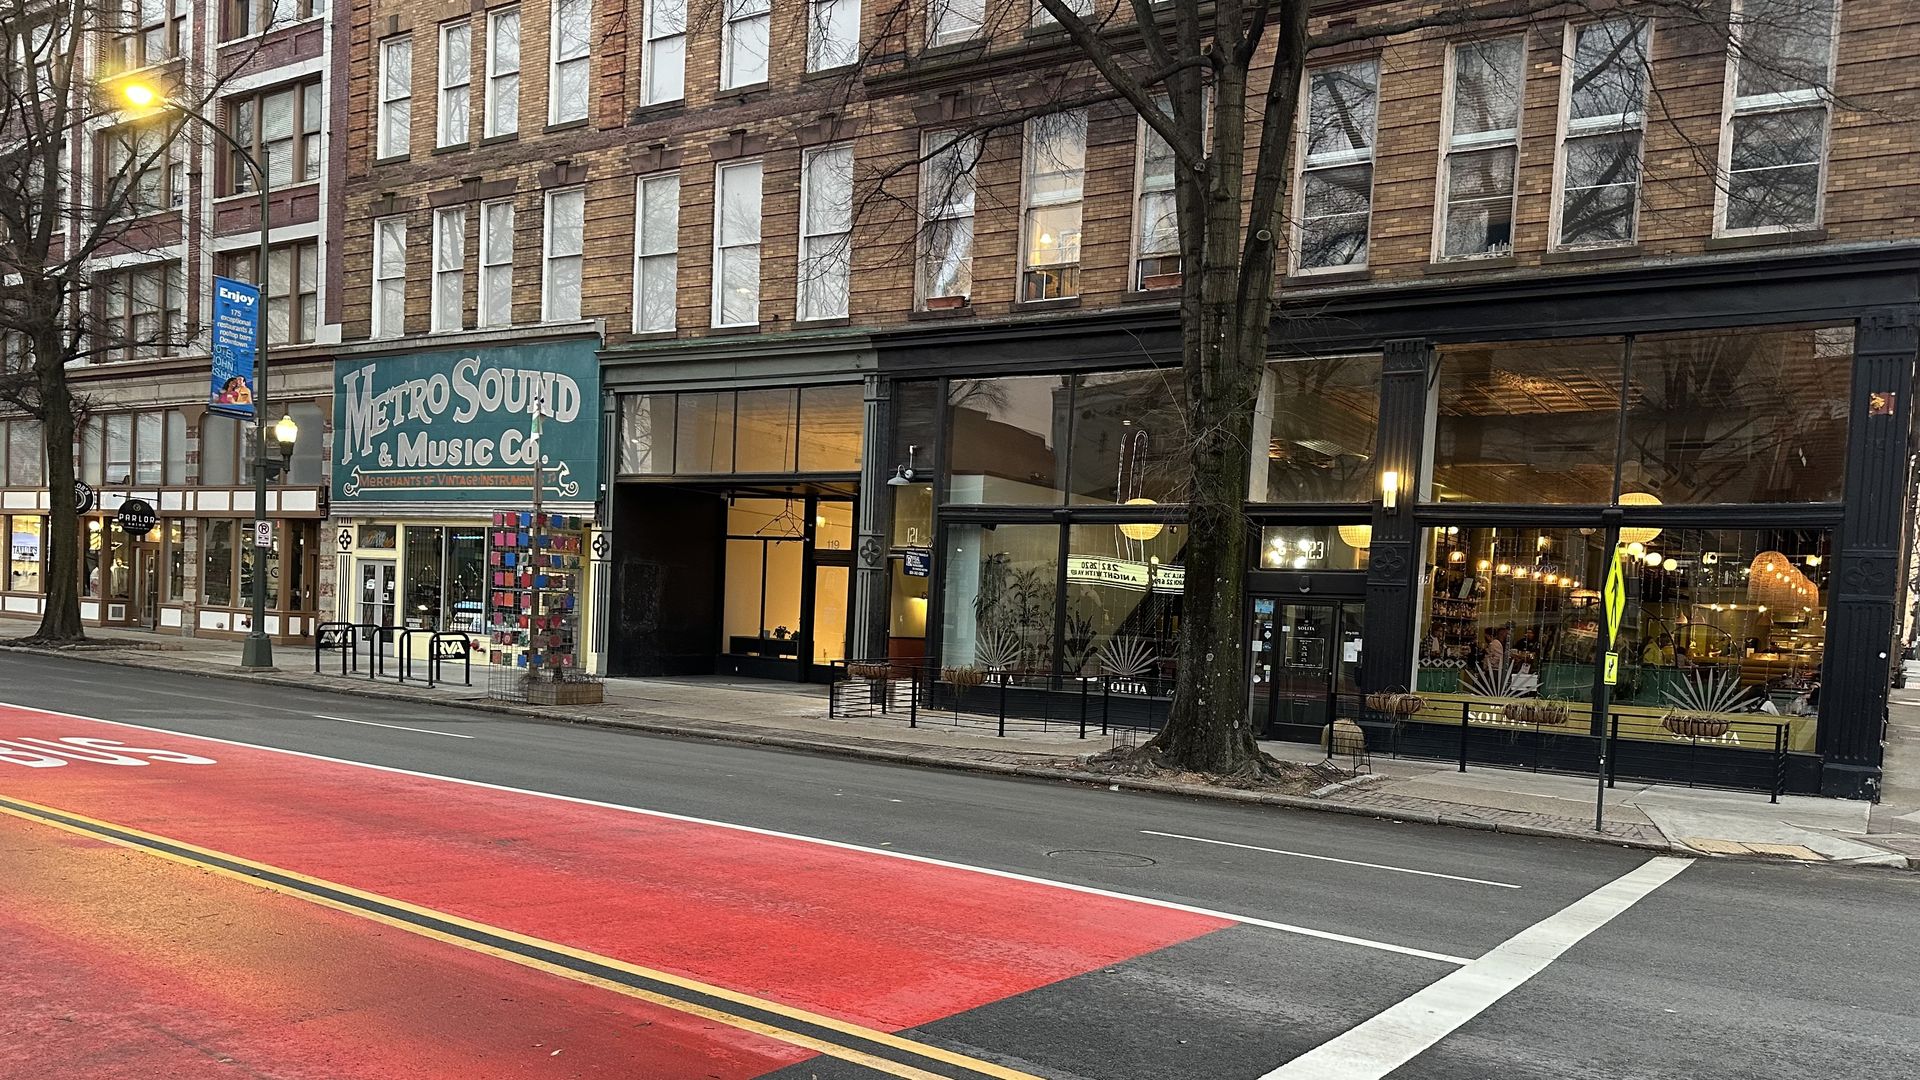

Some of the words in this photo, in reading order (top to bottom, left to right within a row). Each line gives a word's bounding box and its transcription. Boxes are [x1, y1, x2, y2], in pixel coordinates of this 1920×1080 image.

[220, 287, 255, 306] Enjoy
[231, 309, 242, 317] 175
[341, 363, 450, 466] METRO
[452, 355, 581, 424] SOUND
[378, 441, 393, 468] &
[397, 431, 495, 467] MUSIC
[359, 474, 422, 487] MERCHANTS
[423, 474, 436, 487] OF
[438, 474, 479, 487] VINTAGE
[479, 474, 544, 487] INSTRUMEN
[118, 513, 155, 523] PARLOR
[906, 527, 918, 543] 121
[827, 540, 840, 550] 119
